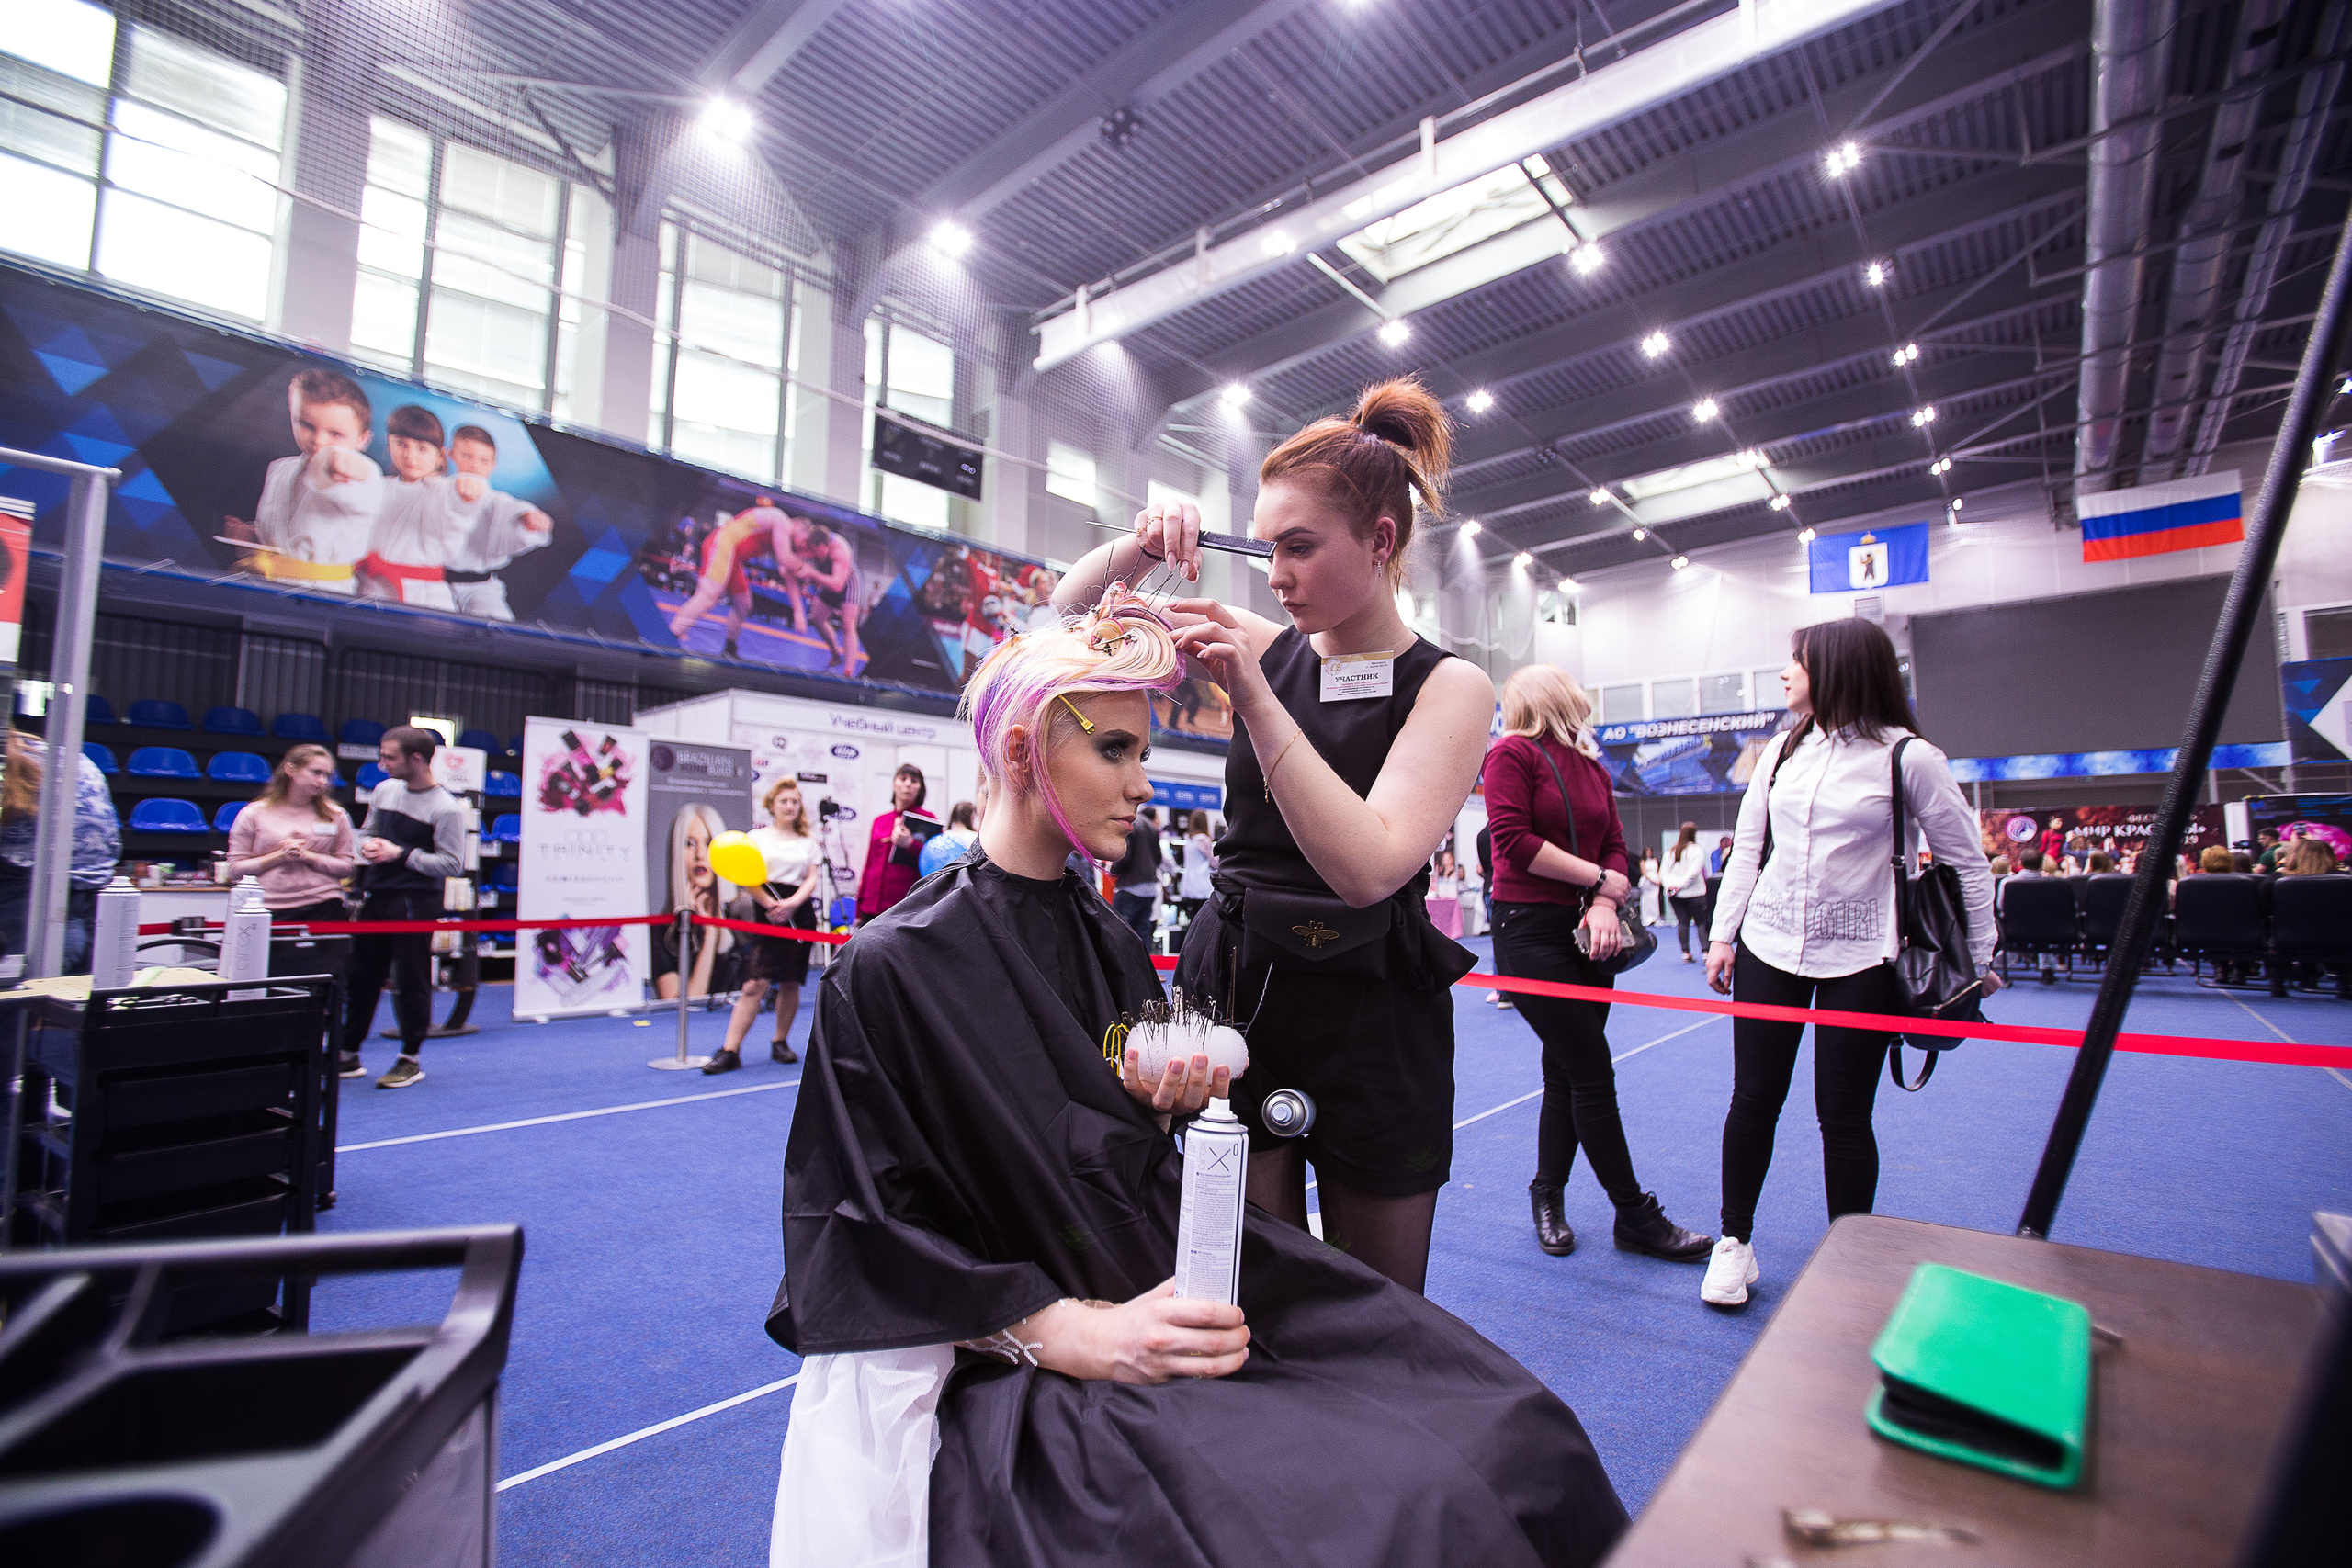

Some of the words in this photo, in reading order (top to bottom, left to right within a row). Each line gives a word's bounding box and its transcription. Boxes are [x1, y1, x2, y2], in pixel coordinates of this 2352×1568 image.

[1335, 673, 1378, 682] УЧАСТНИК
[1602, 726, 1626, 741] АО
[1814, 898, 1879, 941] GIRL
